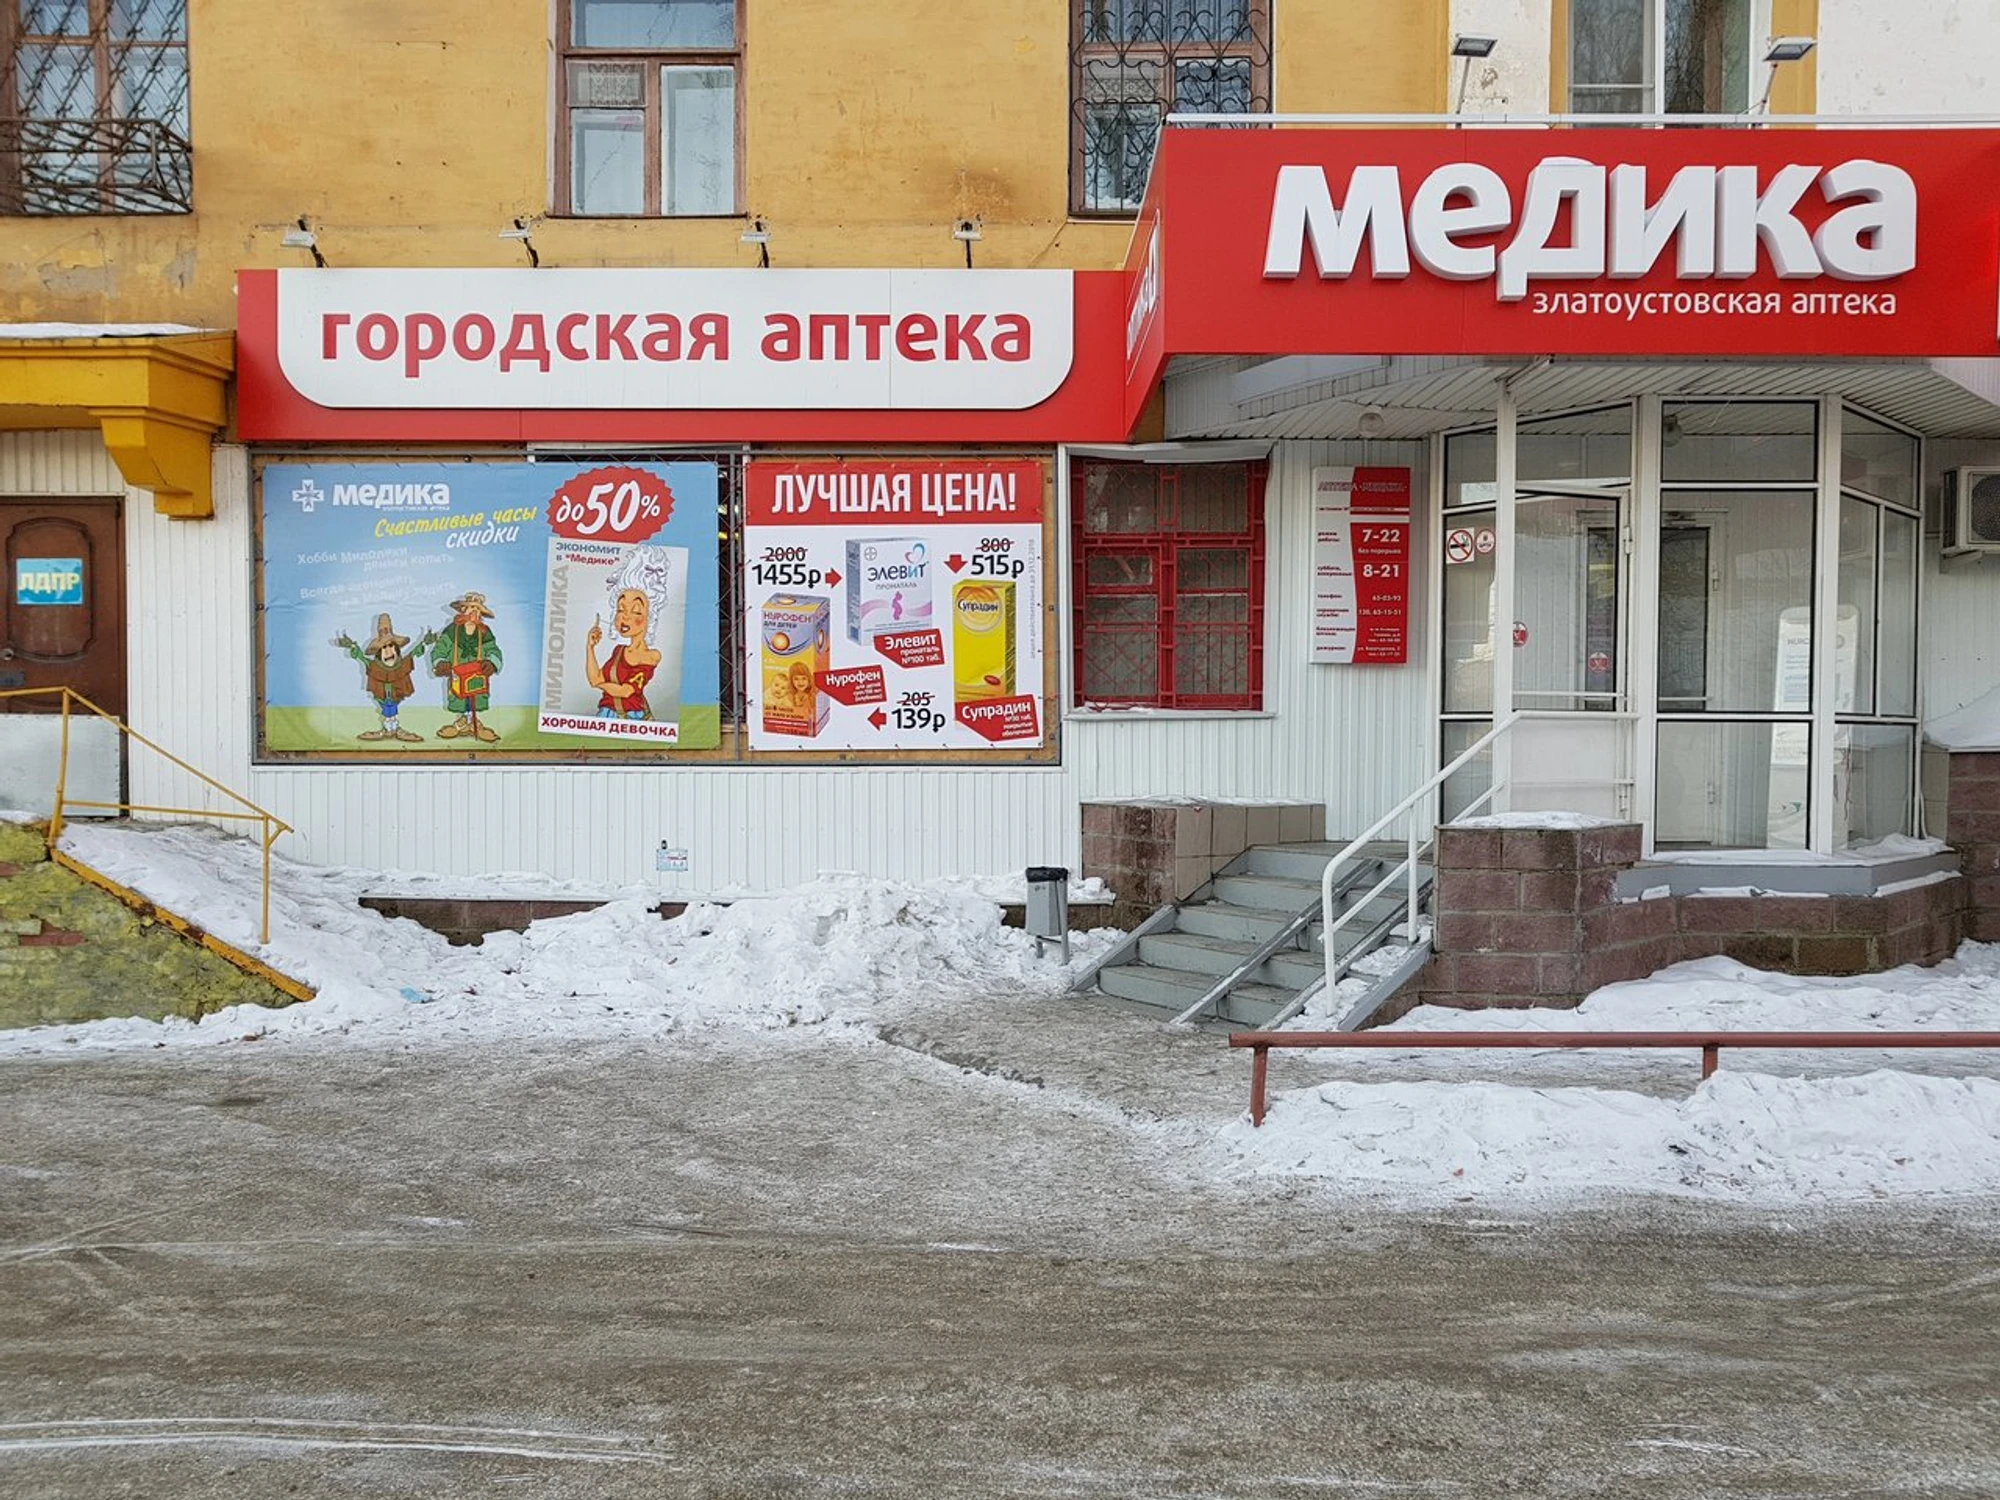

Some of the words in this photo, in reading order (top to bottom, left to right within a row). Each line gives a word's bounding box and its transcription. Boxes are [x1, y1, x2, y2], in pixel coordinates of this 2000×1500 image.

[1263, 156, 1917, 301] медика
[1533, 291, 1780, 320] златоустовская
[1791, 291, 1896, 318] аптека
[322, 313, 730, 377] городская
[760, 313, 1032, 362] аптека
[332, 483, 450, 508] медика
[771, 473, 912, 514] ЛУЧШАЯ
[922, 473, 1016, 516] ЦЕНА!
[556, 495, 584, 524] до
[577, 480, 661, 535] 50%
[375, 514, 484, 538] Счастливые
[492, 505, 538, 522] часы
[445, 522, 520, 549] скидки
[980, 537, 1011, 553] 800
[1362, 529, 1400, 543] 7-22
[297, 552, 337, 565] Хобби
[556, 542, 621, 556] ЭКОНОМИТ
[764, 546, 806, 562] 2000
[1362, 564, 1400, 577] 8-21
[18, 572, 80, 594] ЛДПР
[545, 565, 569, 710] МИЛОЛИКА
[885, 634, 937, 650] Элевит
[826, 670, 881, 687] Нурофен
[901, 692, 931, 706] 205
[962, 702, 1031, 722] Супрадин
[541, 716, 607, 733] ХОРОШАЯ
[609, 721, 678, 738] ДЕВОЧКА
